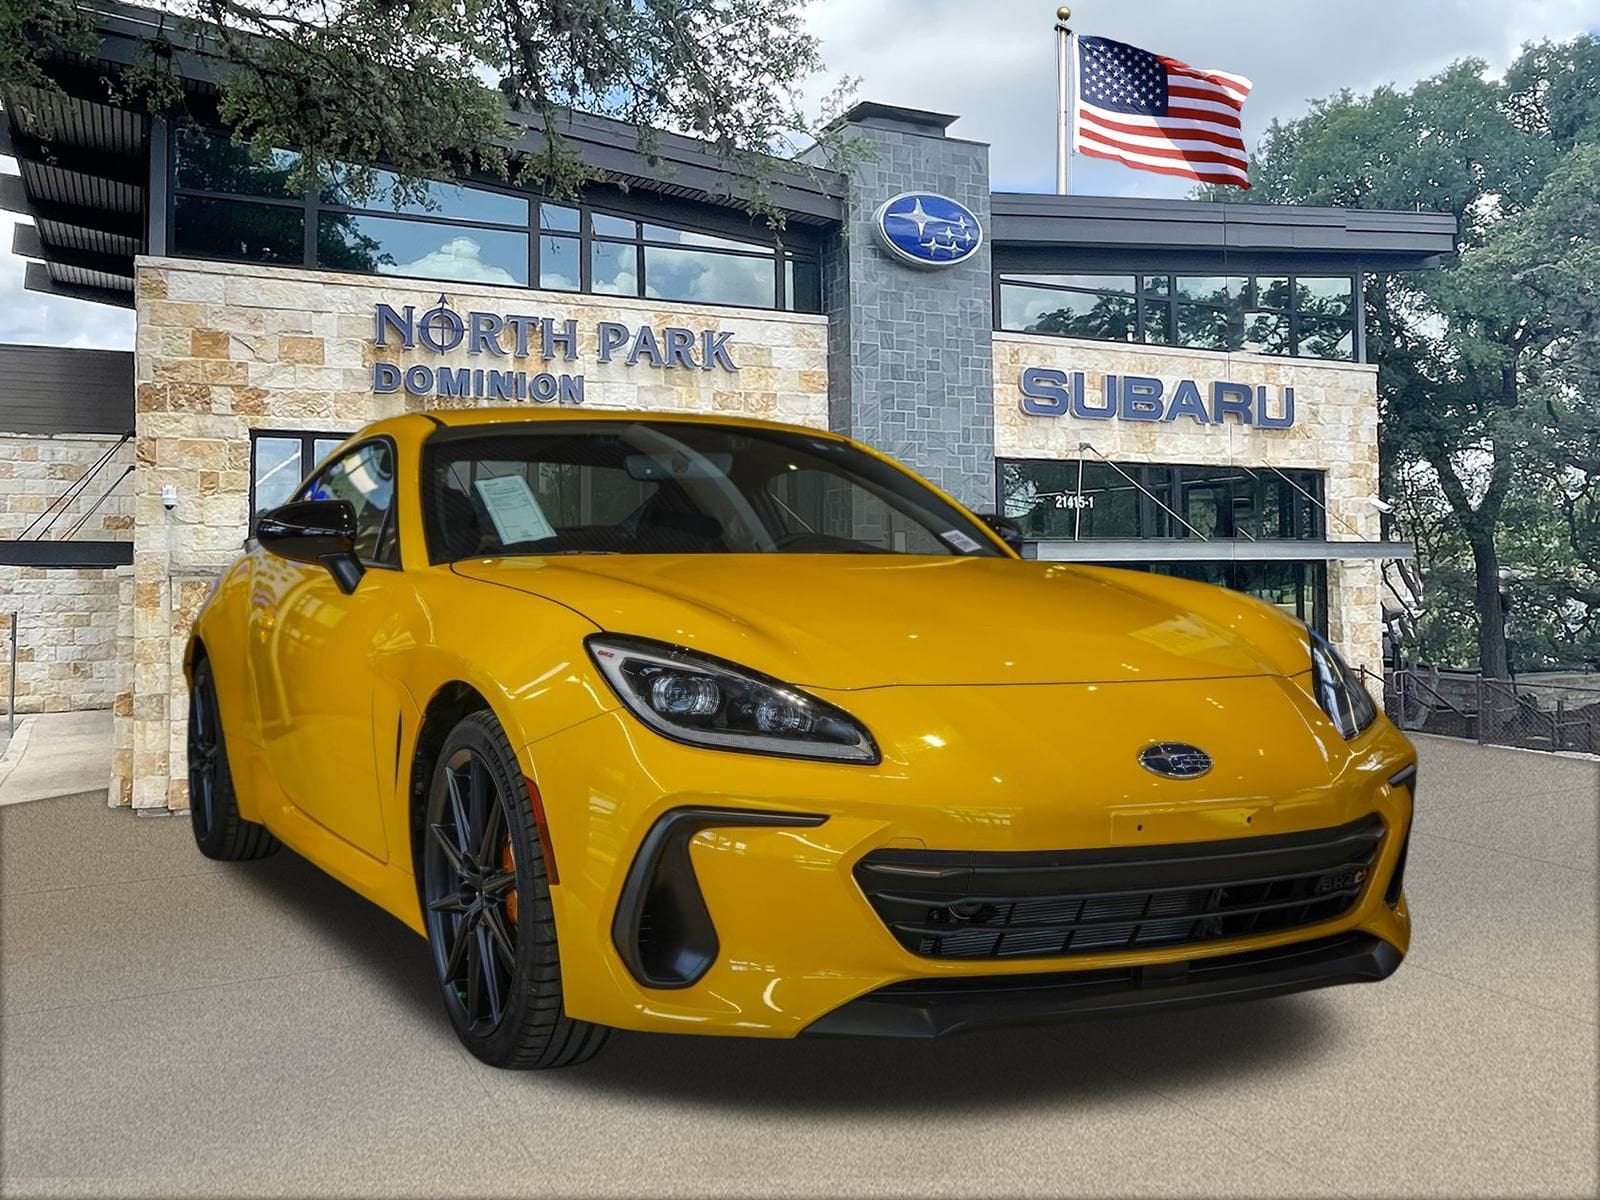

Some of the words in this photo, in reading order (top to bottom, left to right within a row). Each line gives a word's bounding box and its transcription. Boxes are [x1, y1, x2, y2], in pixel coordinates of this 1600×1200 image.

[375, 302, 579, 362] NORTH
[597, 321, 742, 373] PARK
[373, 362, 585, 404] DOMINION
[1018, 366, 1295, 430] SUBARU
